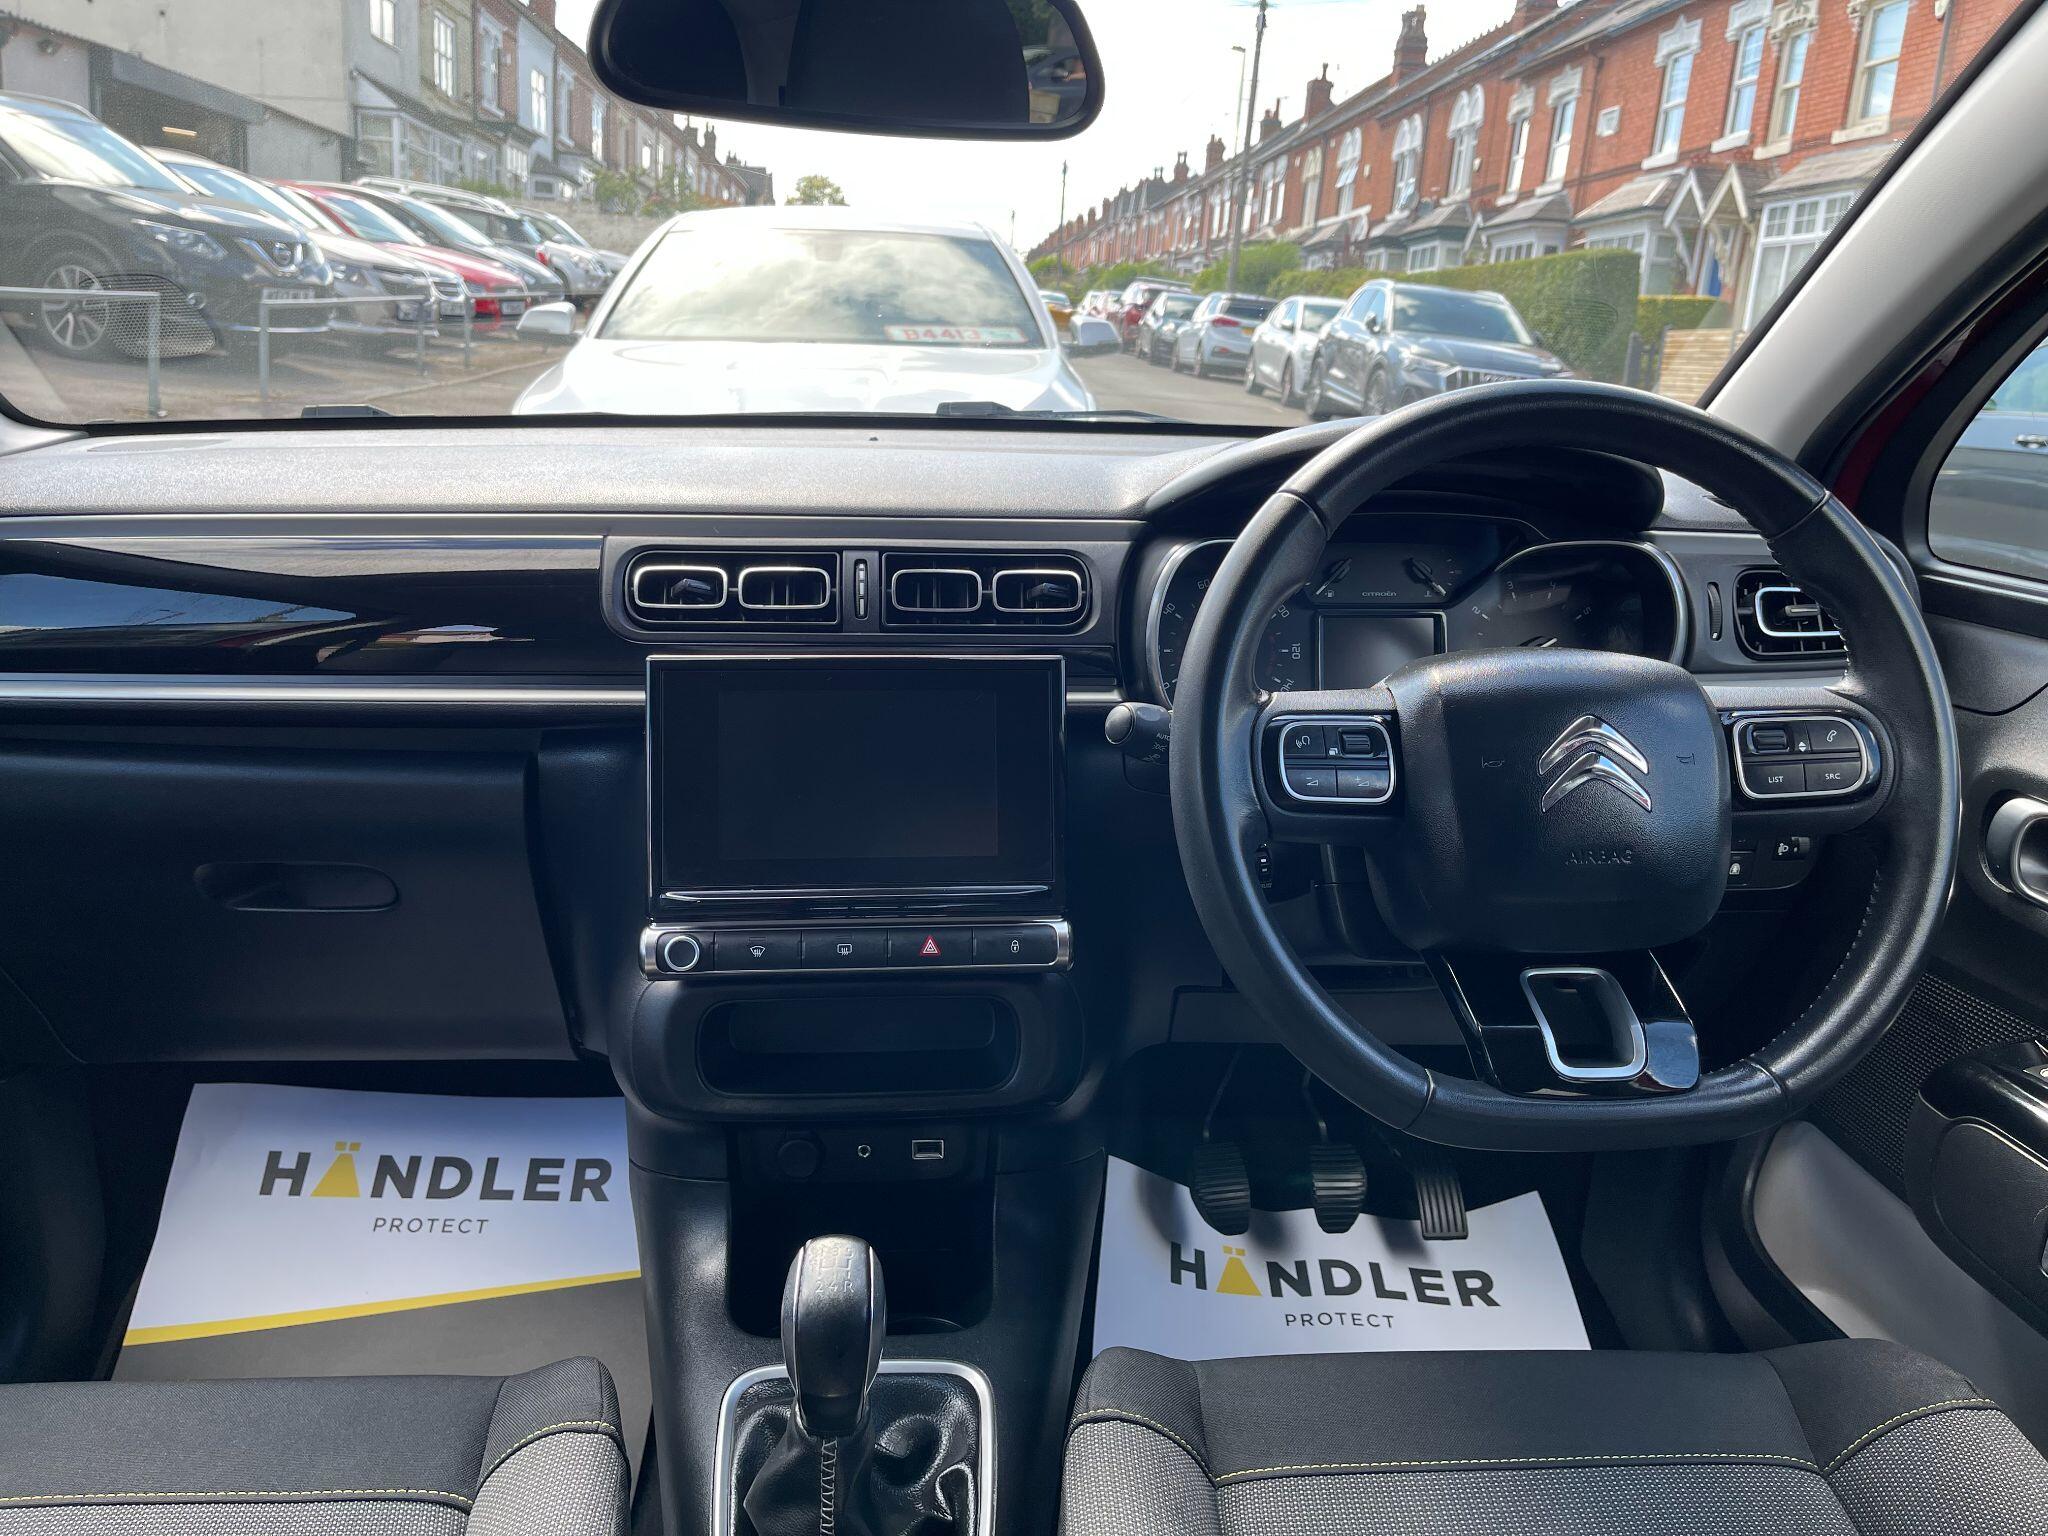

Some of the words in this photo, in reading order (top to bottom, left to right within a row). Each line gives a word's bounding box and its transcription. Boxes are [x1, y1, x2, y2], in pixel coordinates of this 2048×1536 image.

[1291, 643, 1301, 660] 120
[1768, 775, 1784, 783] LIST
[1565, 849, 1632, 865] AIRBAG
[259, 1141, 612, 1202] HÄNDLER
[373, 1217, 490, 1235] PROTECT
[1169, 1241, 1501, 1308] HÄNDLER
[1285, 1312, 1395, 1329] PROTECT
